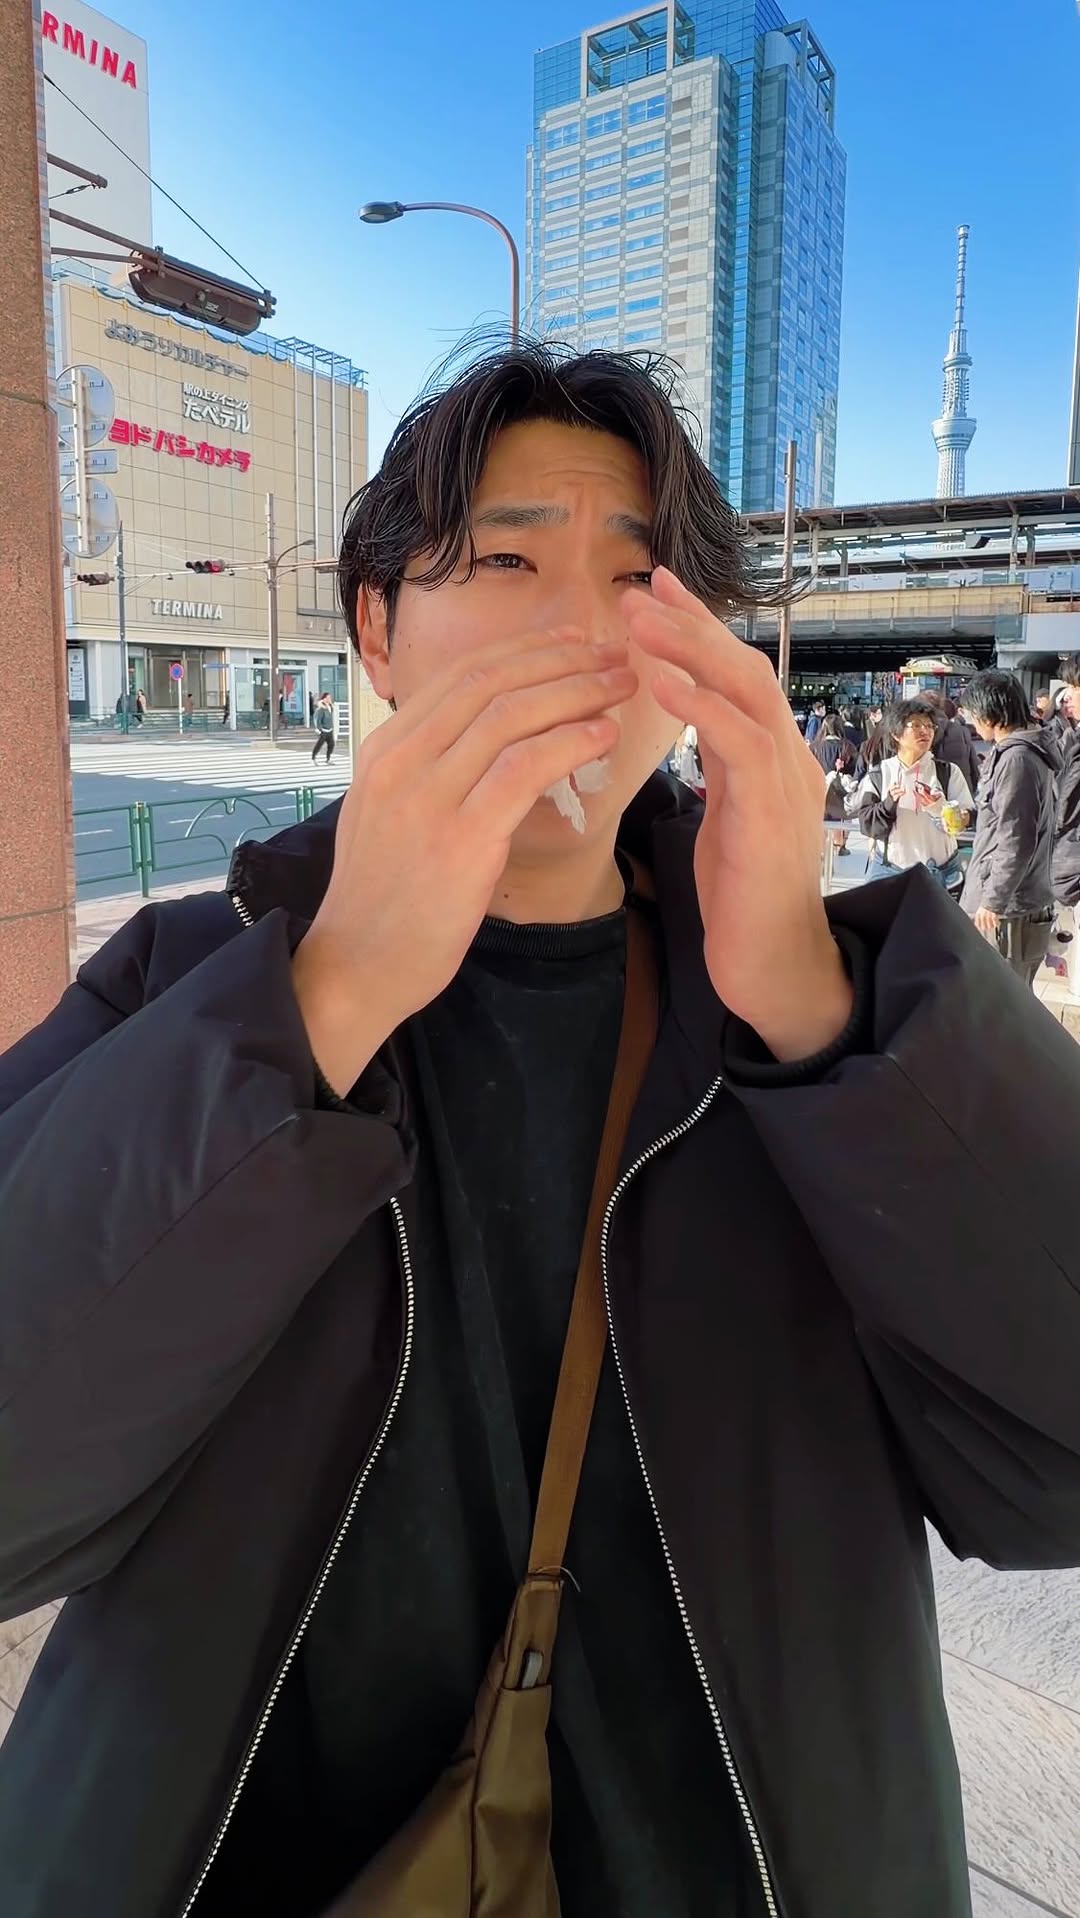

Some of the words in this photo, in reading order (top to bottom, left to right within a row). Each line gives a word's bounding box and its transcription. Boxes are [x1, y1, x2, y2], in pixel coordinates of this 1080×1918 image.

[42, 11, 137, 89] RMINA
[109, 418, 251, 472] ヨドバシカメラ
[151, 599, 223, 619] TERMINA
